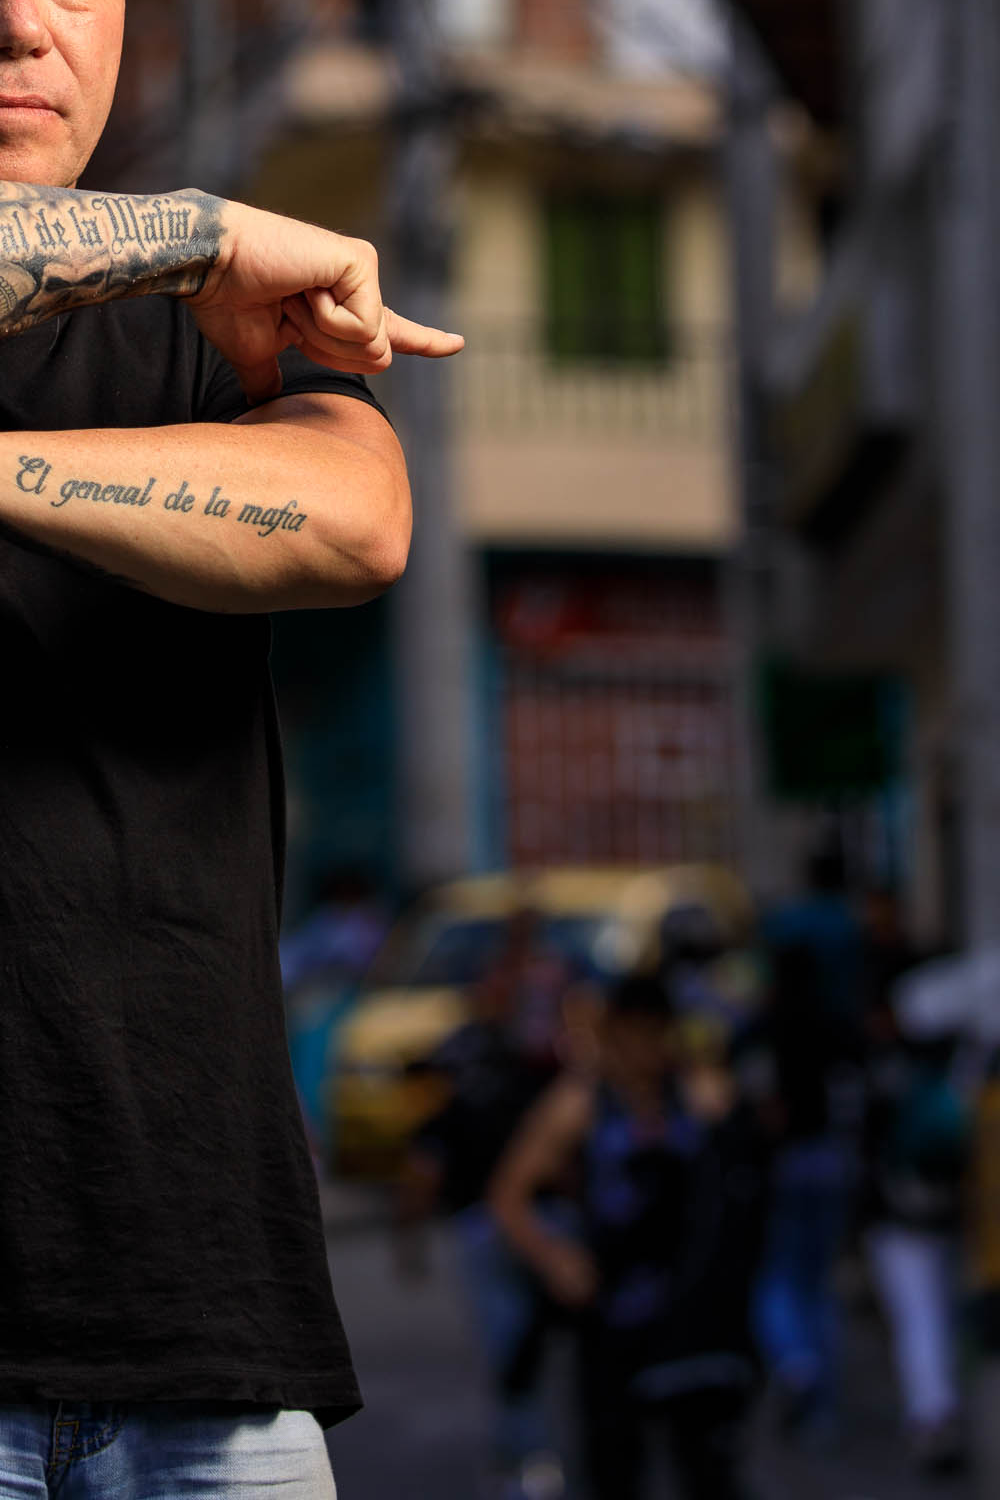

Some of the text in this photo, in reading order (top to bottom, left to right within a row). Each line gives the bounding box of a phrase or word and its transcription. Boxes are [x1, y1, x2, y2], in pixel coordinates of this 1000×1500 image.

[35, 210, 72, 251] de
[70, 206, 103, 247] la
[15, 455, 307, 537] El general de la mafia
